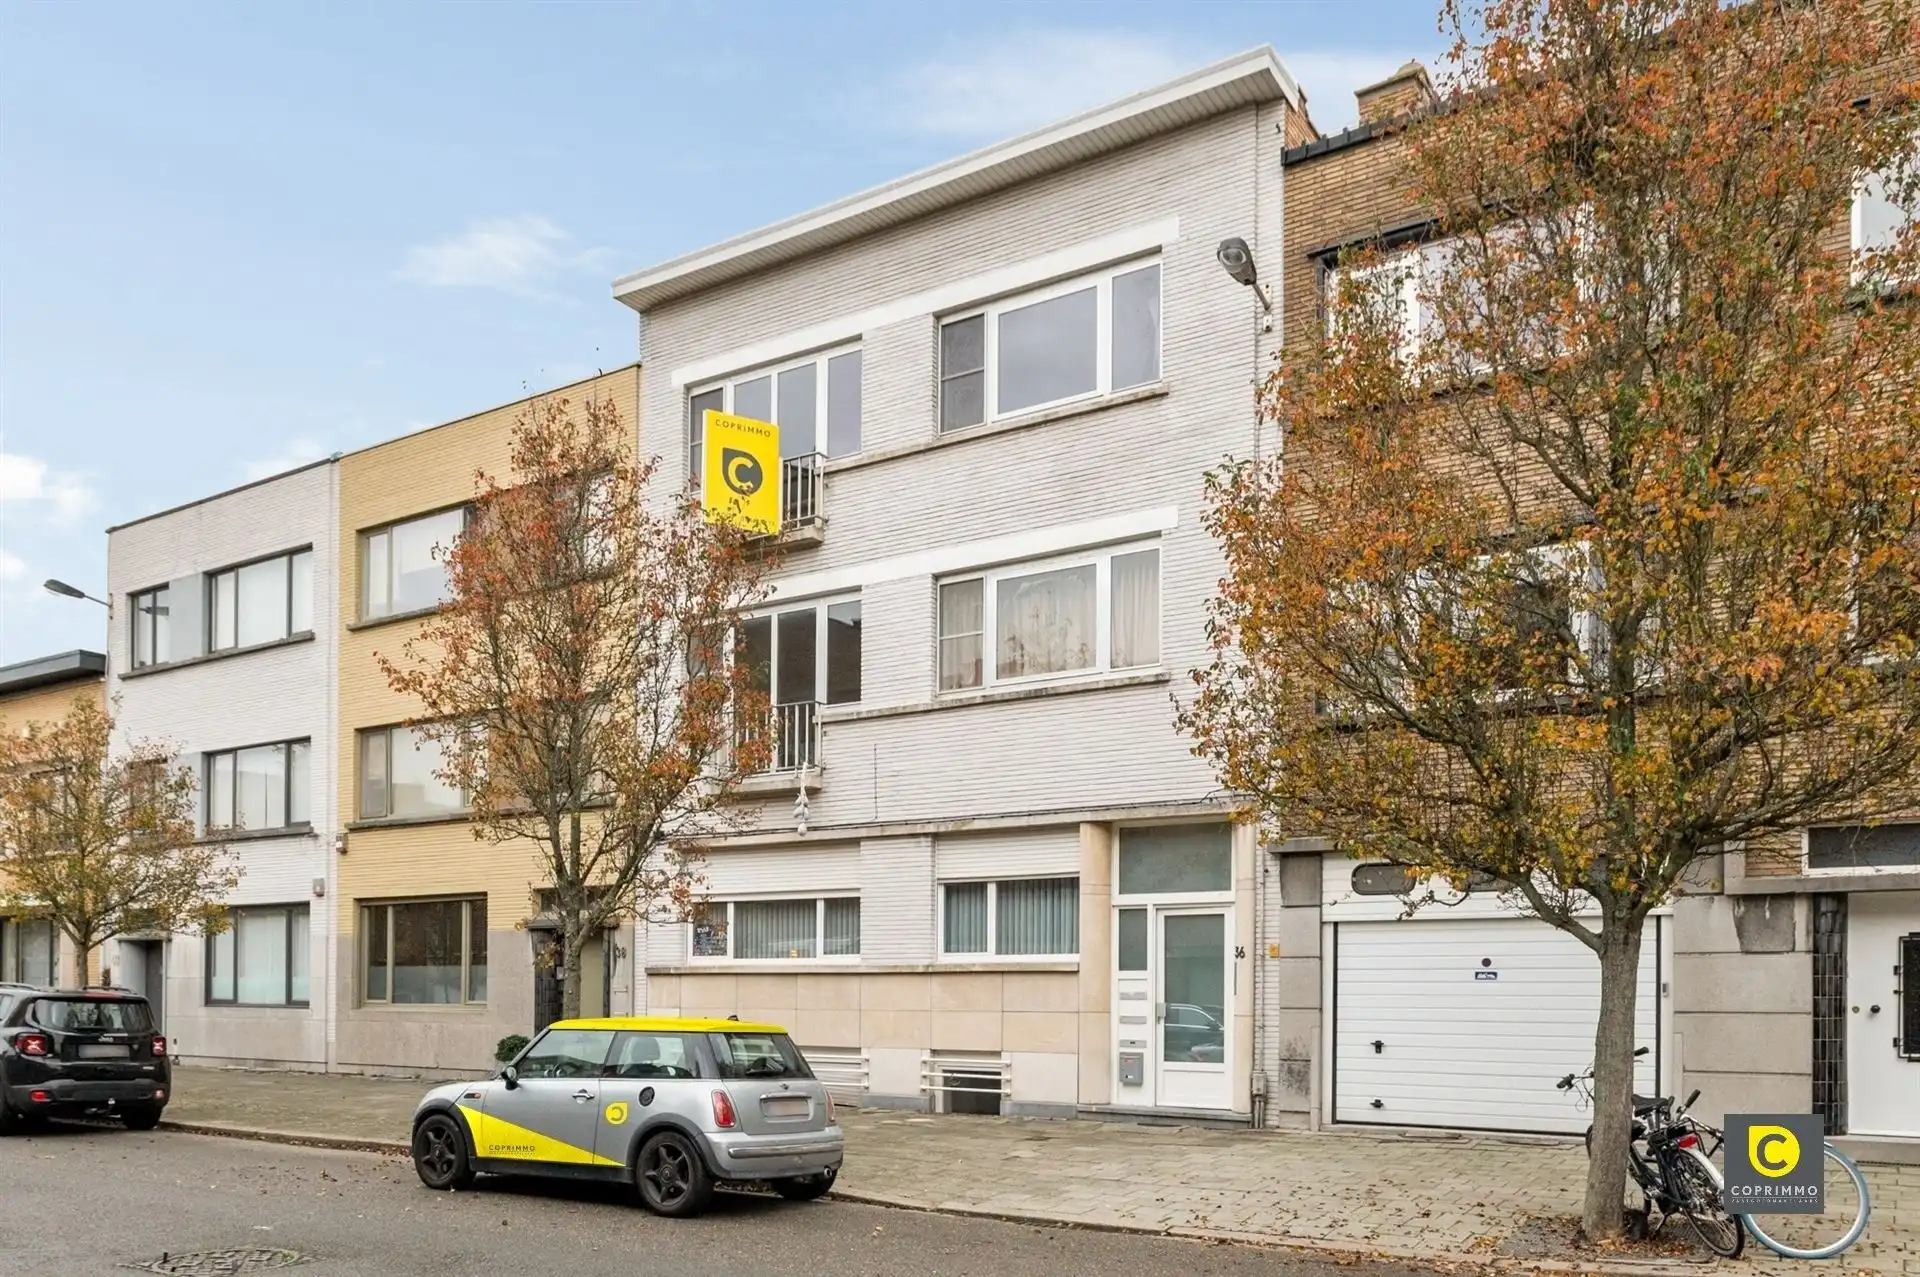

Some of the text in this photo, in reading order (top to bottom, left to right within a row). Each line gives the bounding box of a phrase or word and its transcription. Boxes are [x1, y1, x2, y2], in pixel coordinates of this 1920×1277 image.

[715, 419, 771, 438] COPRIMMO
[728, 456, 754, 490] C
[1235, 945, 1246, 959] 36
[488, 1144, 536, 1152] COPRIMMO
